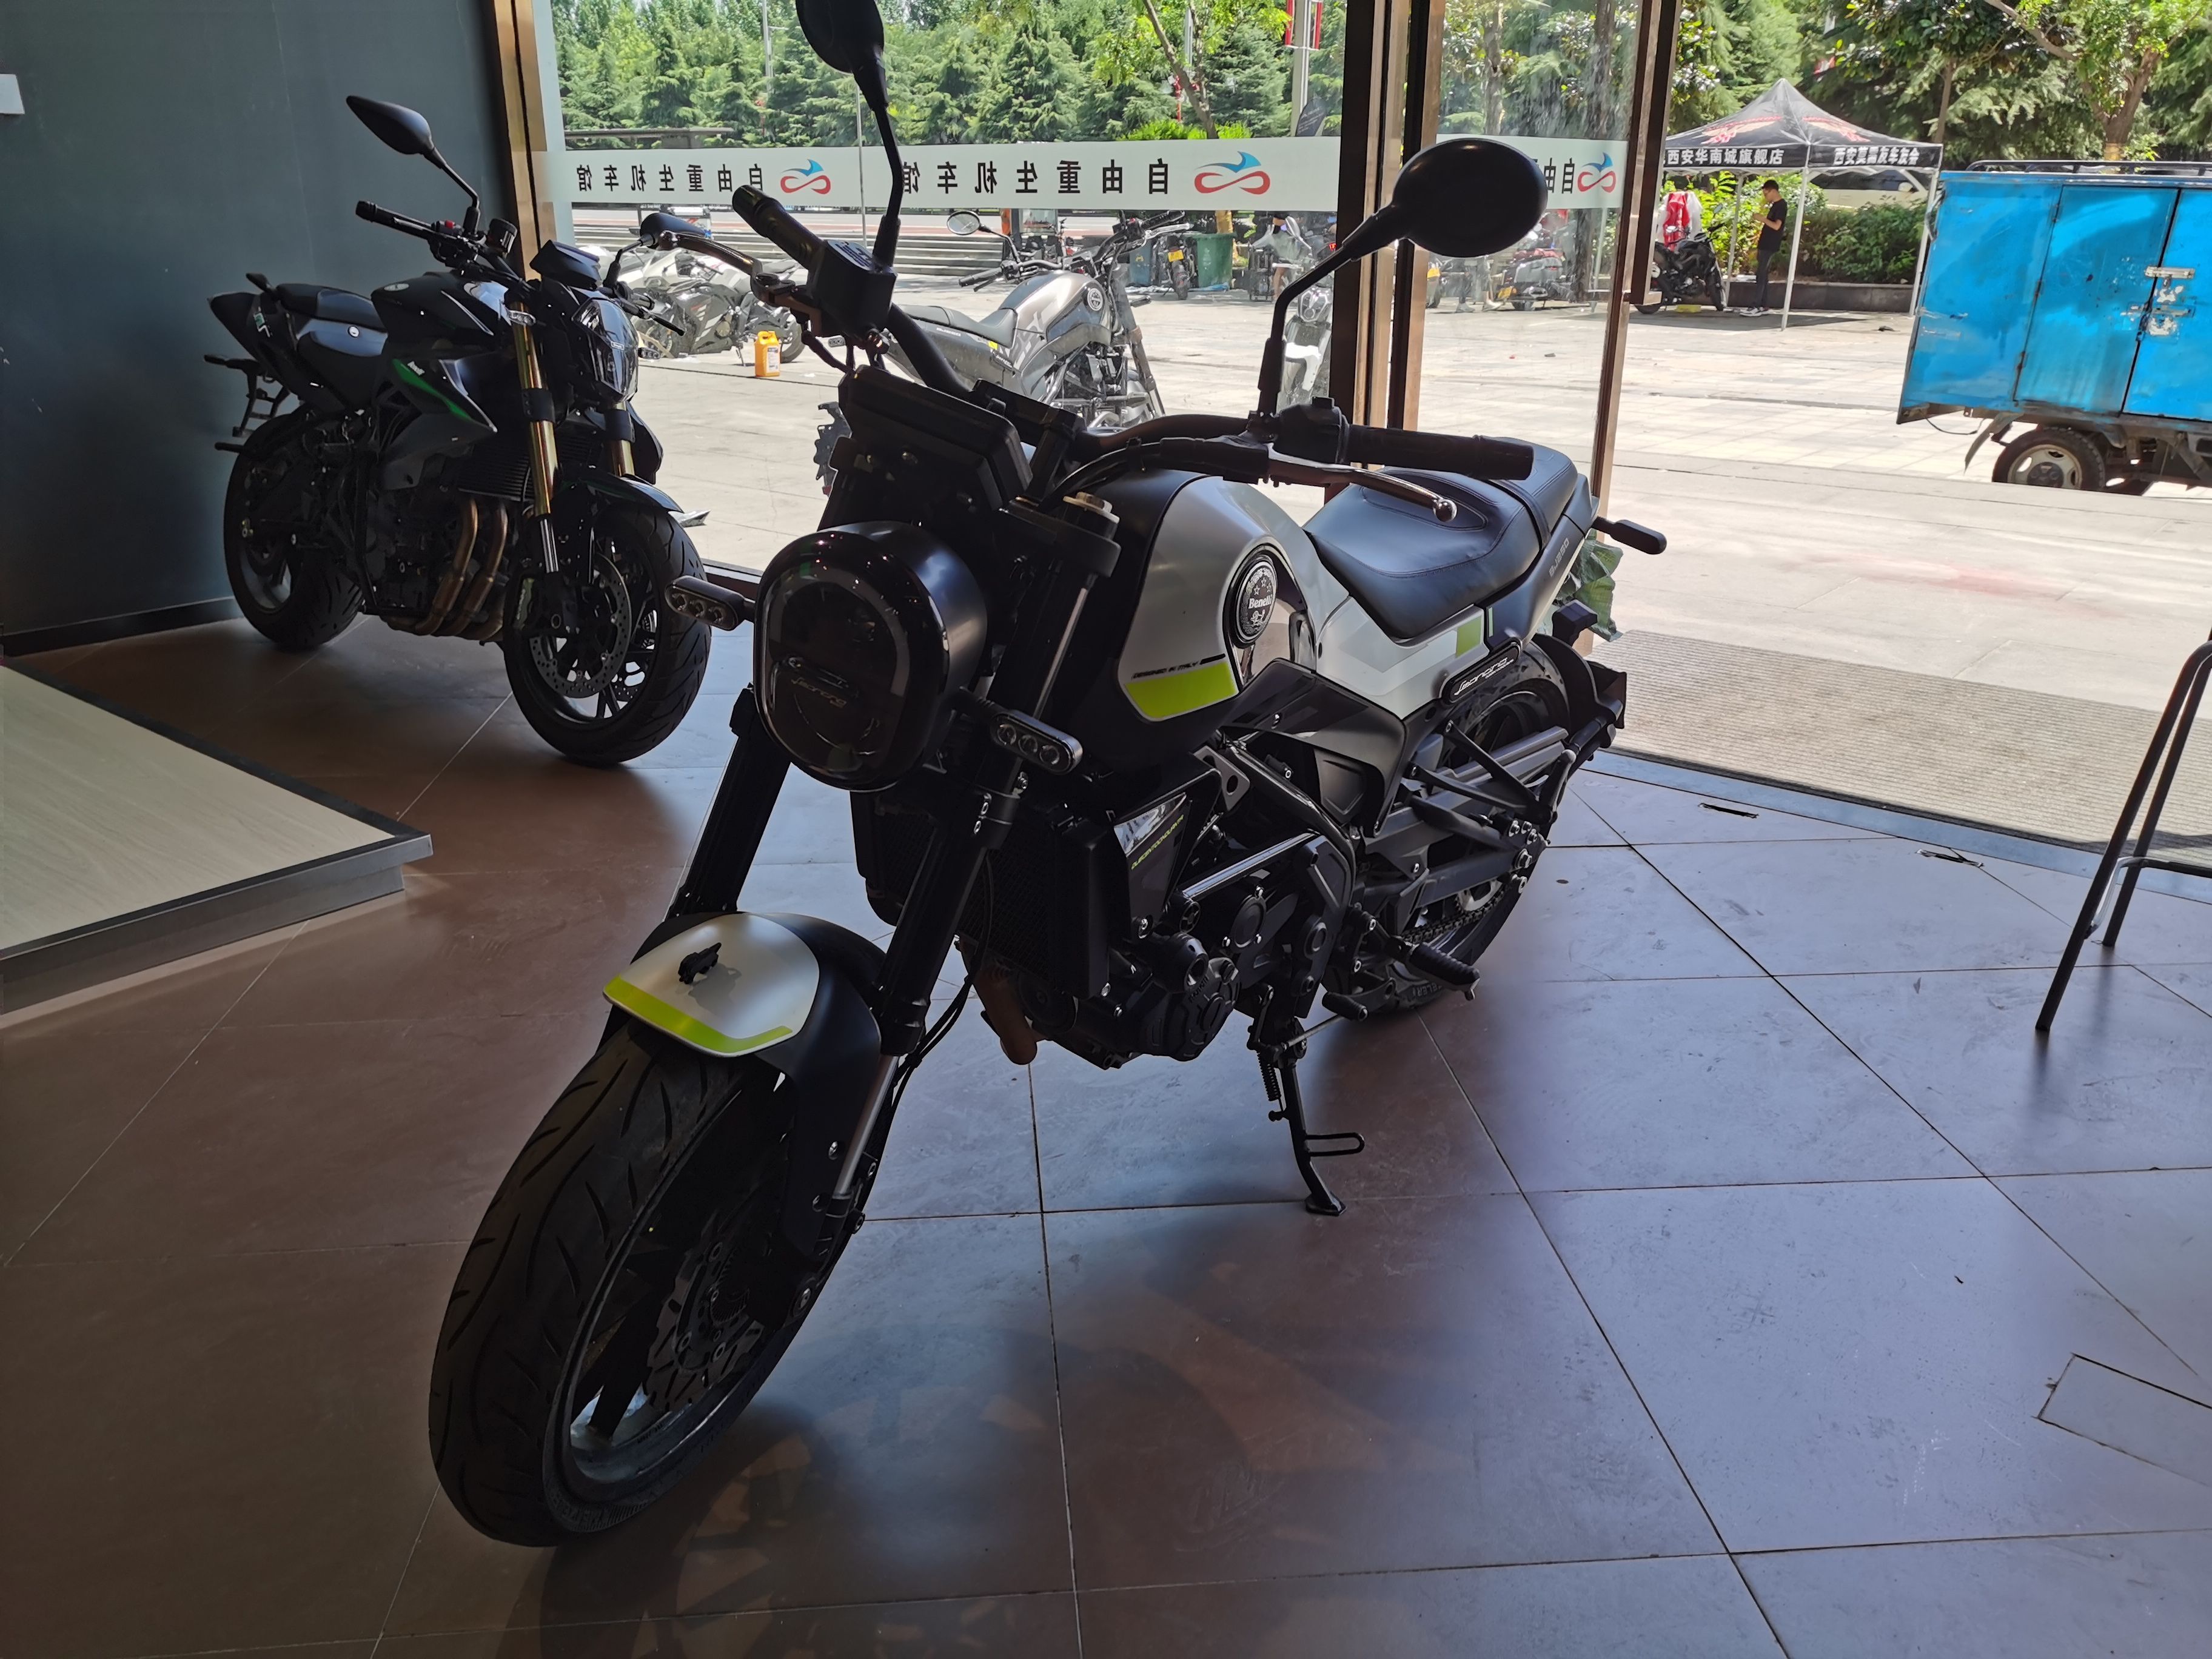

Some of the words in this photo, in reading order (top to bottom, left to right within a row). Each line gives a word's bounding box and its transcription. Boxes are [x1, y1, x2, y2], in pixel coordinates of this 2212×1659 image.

[1663, 148, 1785, 166] 西安华南城旗舰店
[1549, 537, 1569, 577] BJ250
[1248, 594, 1273, 609] Benelli
